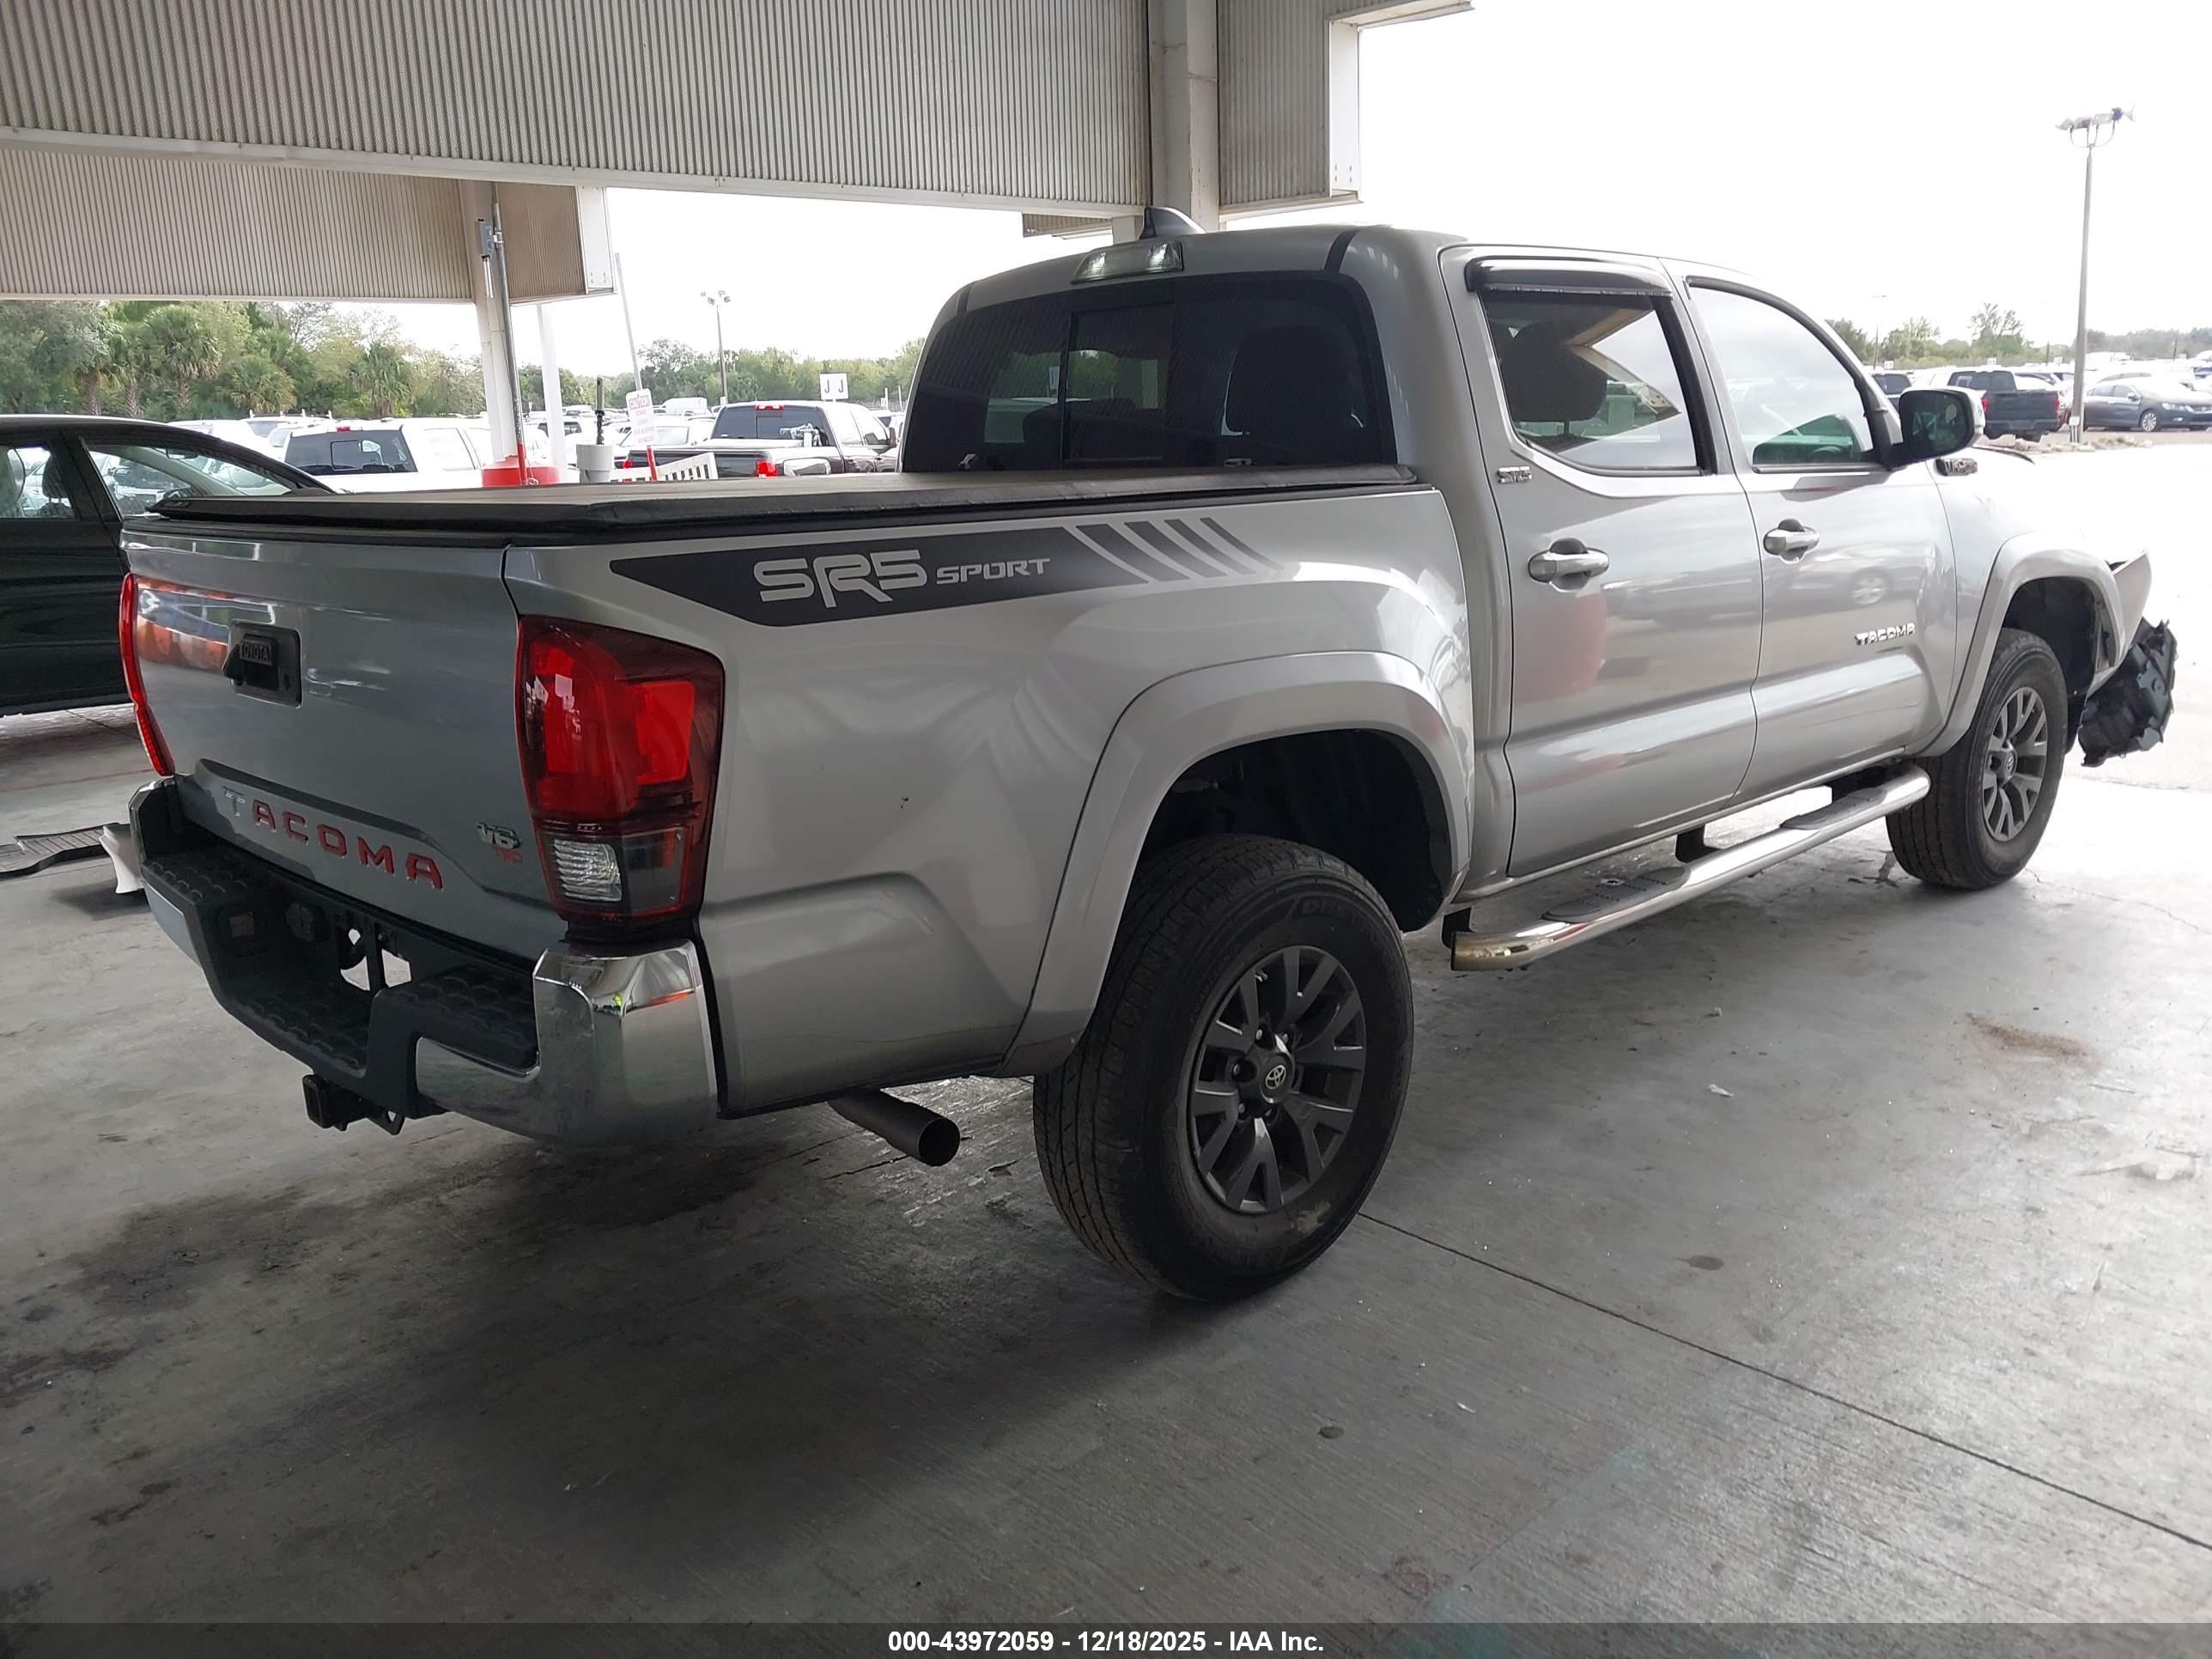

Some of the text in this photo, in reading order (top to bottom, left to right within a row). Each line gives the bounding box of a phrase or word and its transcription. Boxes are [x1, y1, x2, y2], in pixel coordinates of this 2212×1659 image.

[753, 549, 1050, 609] SR5 SPORT
[222, 785, 444, 892] TACOMA
[476, 823, 520, 849] V6
